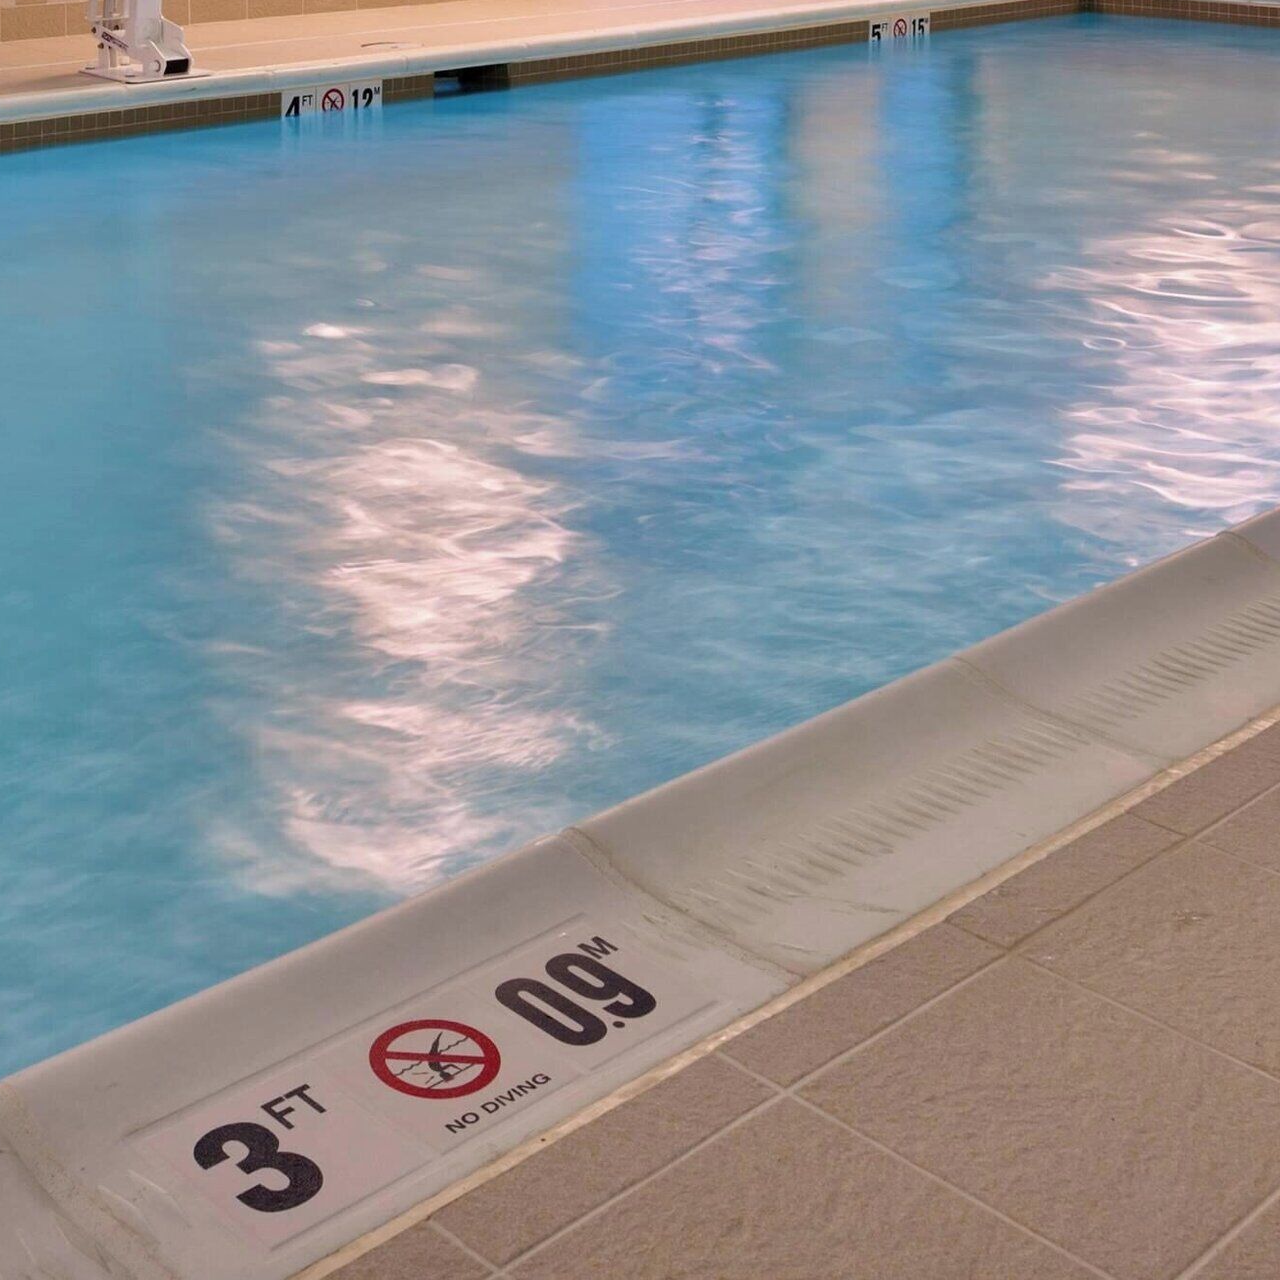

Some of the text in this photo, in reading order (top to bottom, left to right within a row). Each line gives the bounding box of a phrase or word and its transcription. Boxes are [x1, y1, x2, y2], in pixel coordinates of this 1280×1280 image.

[302, 95, 313, 106] FT
[494, 935, 657, 1046] 0.9 M
[445, 1072, 552, 1134] NO DIVING
[193, 1083, 327, 1213] 3 FT
